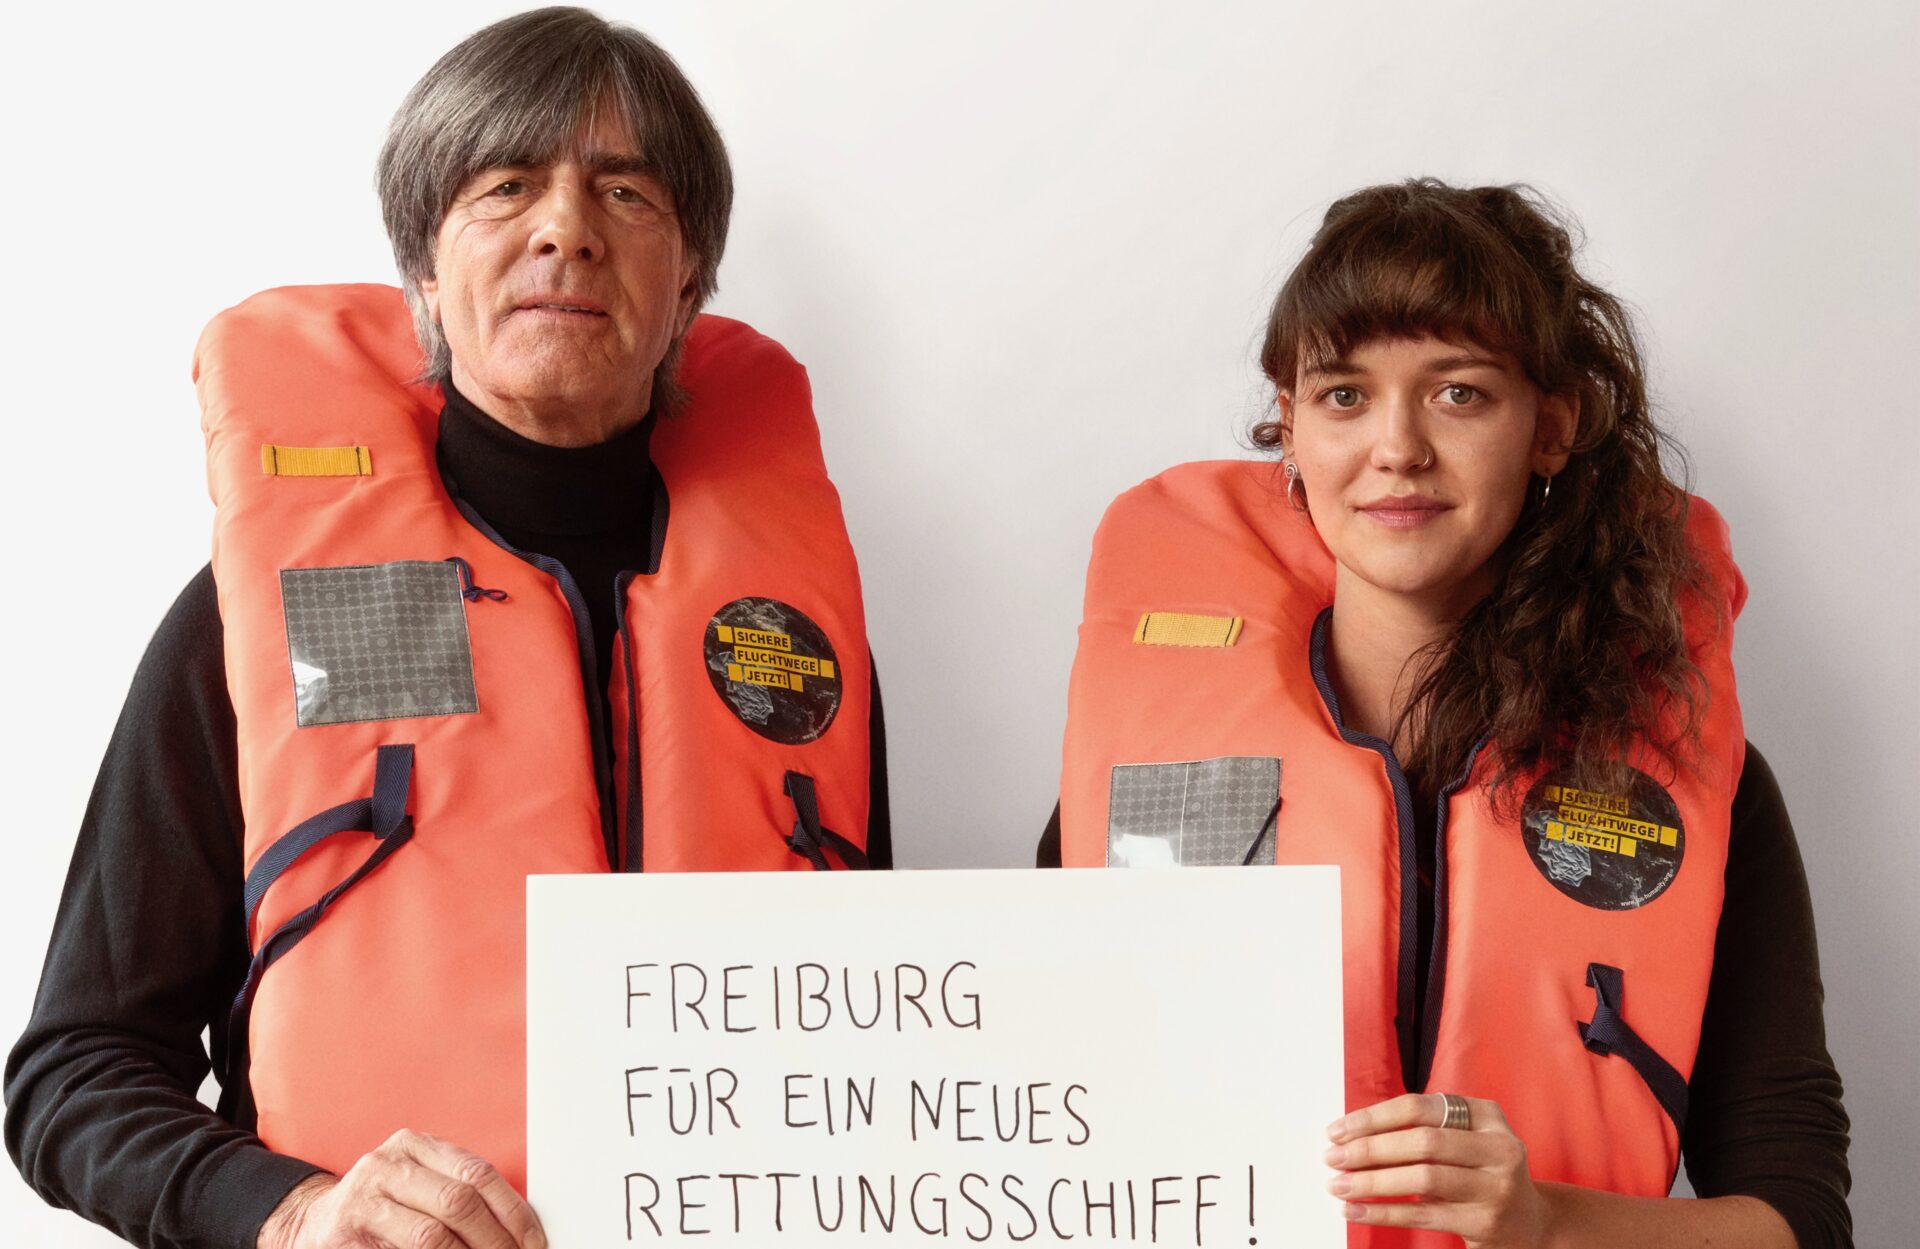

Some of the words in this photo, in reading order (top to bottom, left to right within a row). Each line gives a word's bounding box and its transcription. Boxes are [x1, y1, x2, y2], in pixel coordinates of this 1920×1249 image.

[737, 631, 789, 648] SICHERE
[737, 650, 816, 672] FLUCHTWEGE
[746, 670, 787, 686] JETZT!
[1565, 791, 1627, 812] SICHERE
[1561, 808, 1656, 838] FLUCHTWEGE
[1568, 830, 1615, 849] JETZT!
[626, 962, 981, 1033] FREIBURG
[785, 1074, 876, 1136] EIN
[911, 1077, 1090, 1146] NEUES
[624, 1165, 1258, 1247] RETTUNGSSCHIFF!
